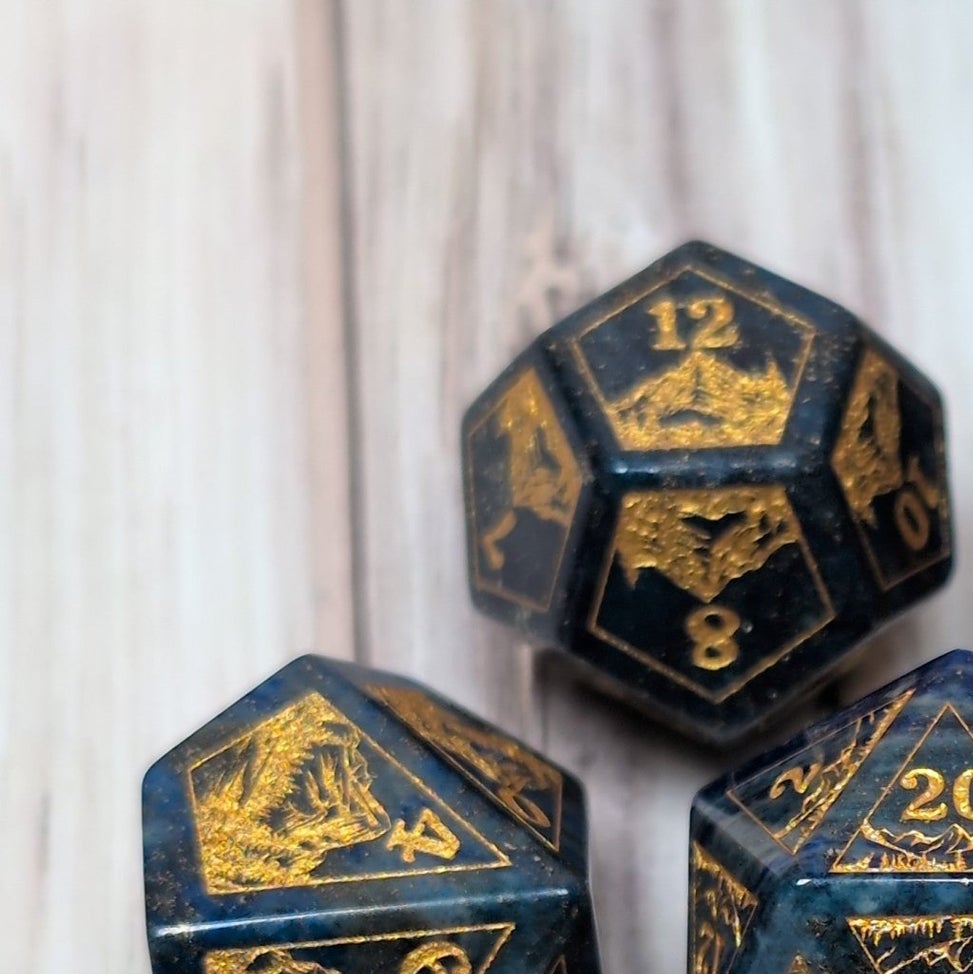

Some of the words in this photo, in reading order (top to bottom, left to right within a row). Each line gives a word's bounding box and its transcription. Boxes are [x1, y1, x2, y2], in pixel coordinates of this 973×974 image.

[647, 295, 740, 351] 12
[482, 508, 518, 572] 7
[685, 604, 741, 670] 8
[768, 762, 820, 800] 2
[386, 807, 461, 863] 4
